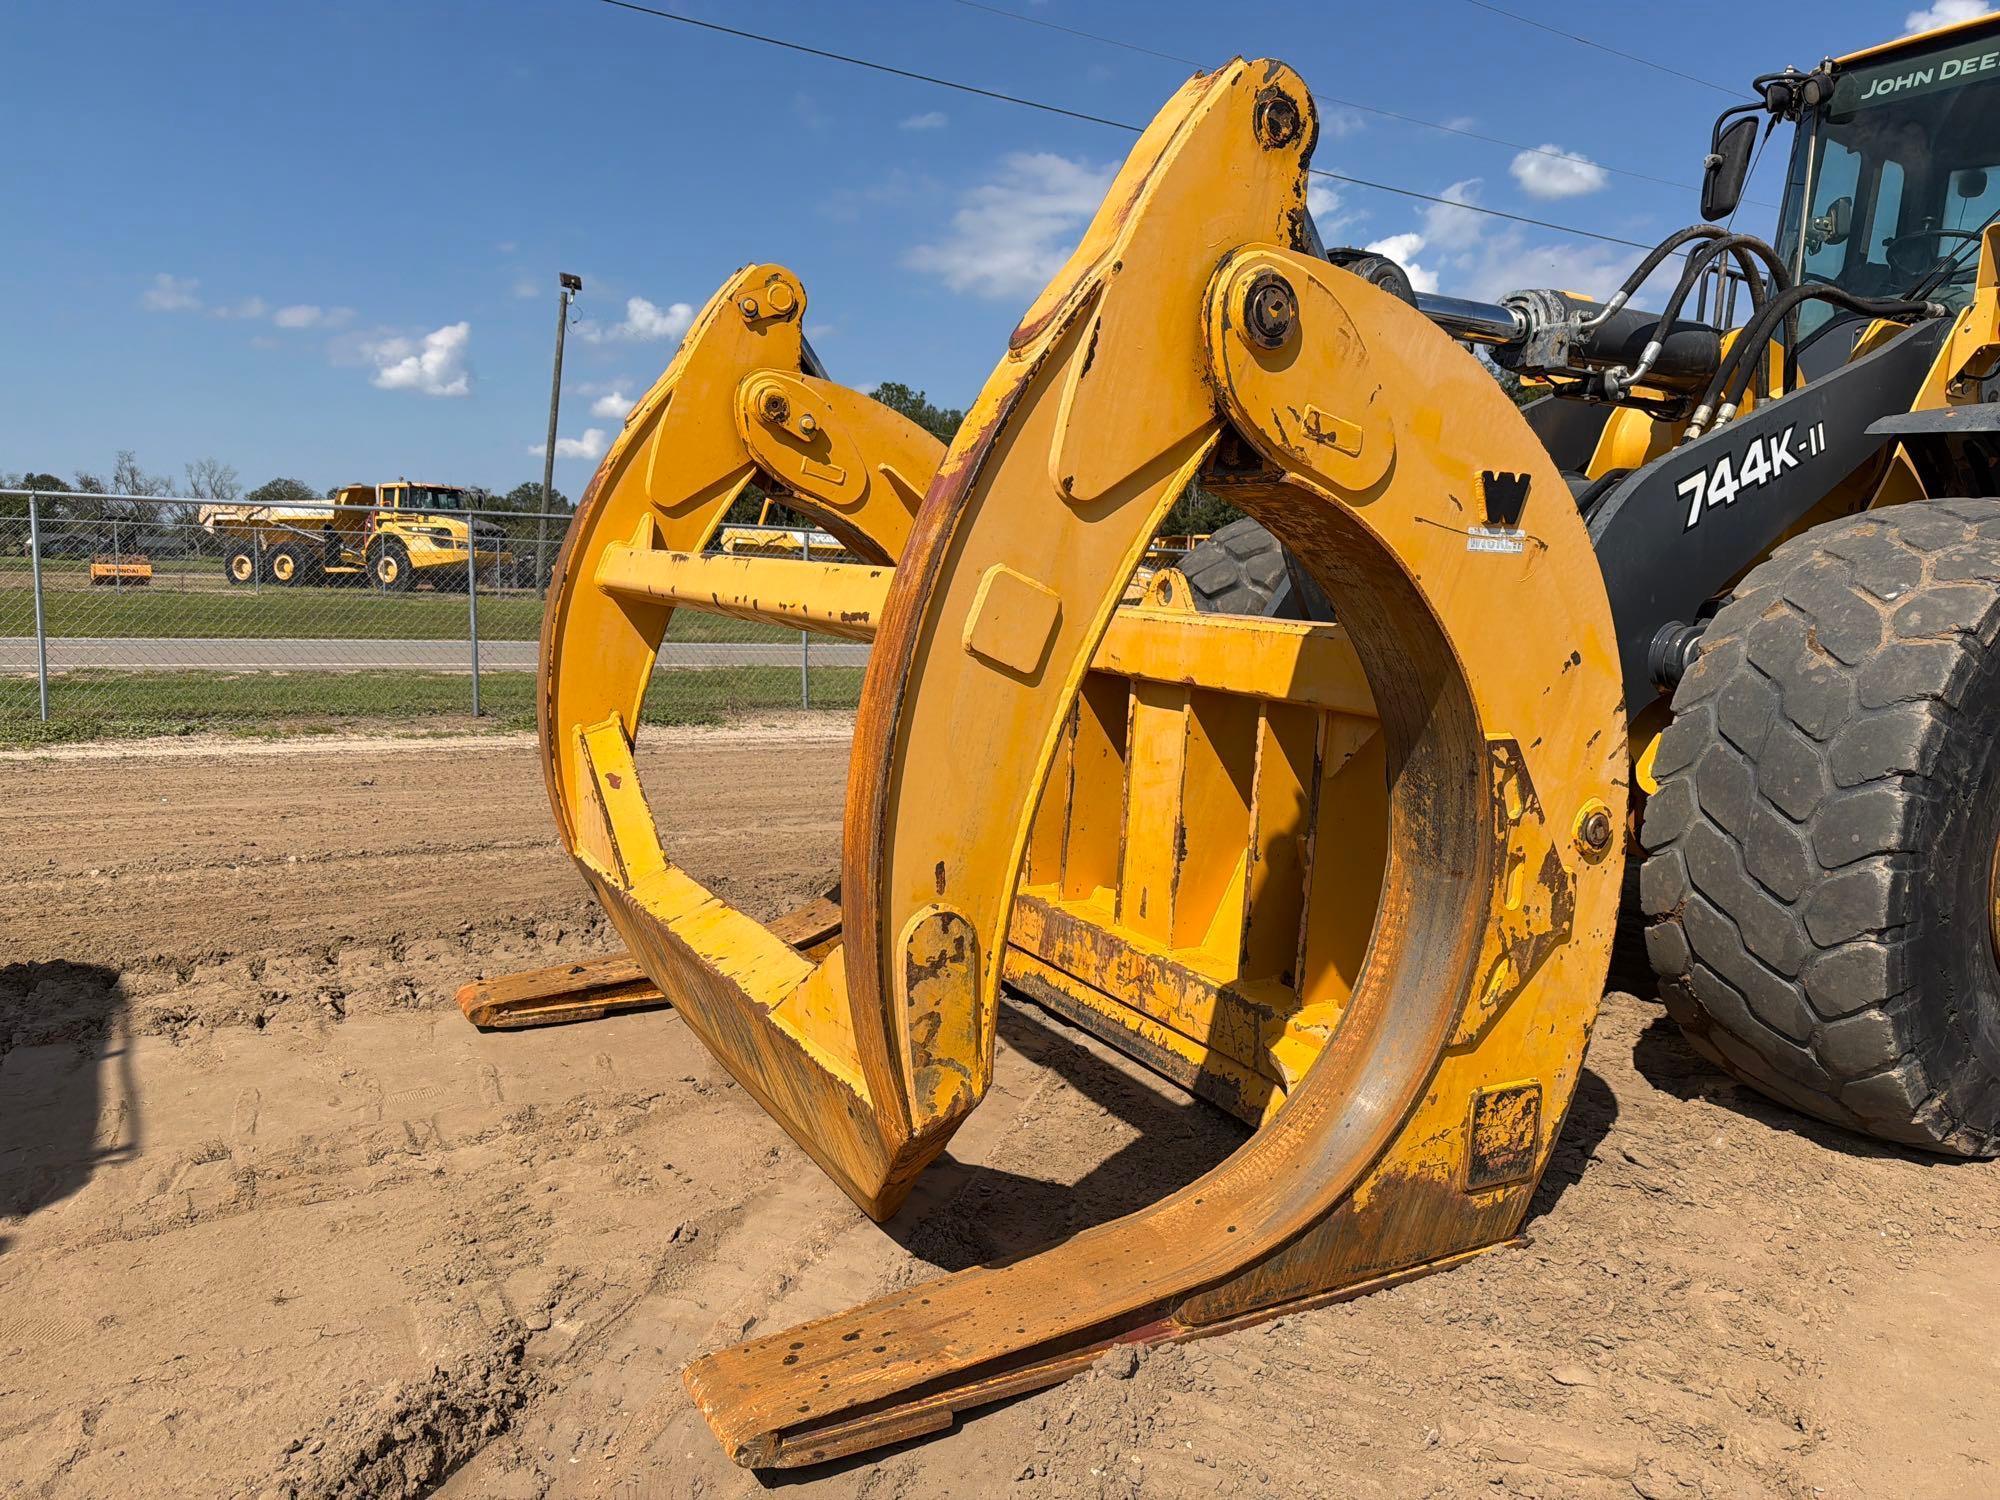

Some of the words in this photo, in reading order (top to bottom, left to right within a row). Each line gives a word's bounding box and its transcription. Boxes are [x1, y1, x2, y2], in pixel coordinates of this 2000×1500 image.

[1860, 68, 1934, 100] JOHN
[1938, 51, 2000, 80] DEE
[1481, 470, 1531, 525] W
[1676, 421, 1826, 530] 744K-II
